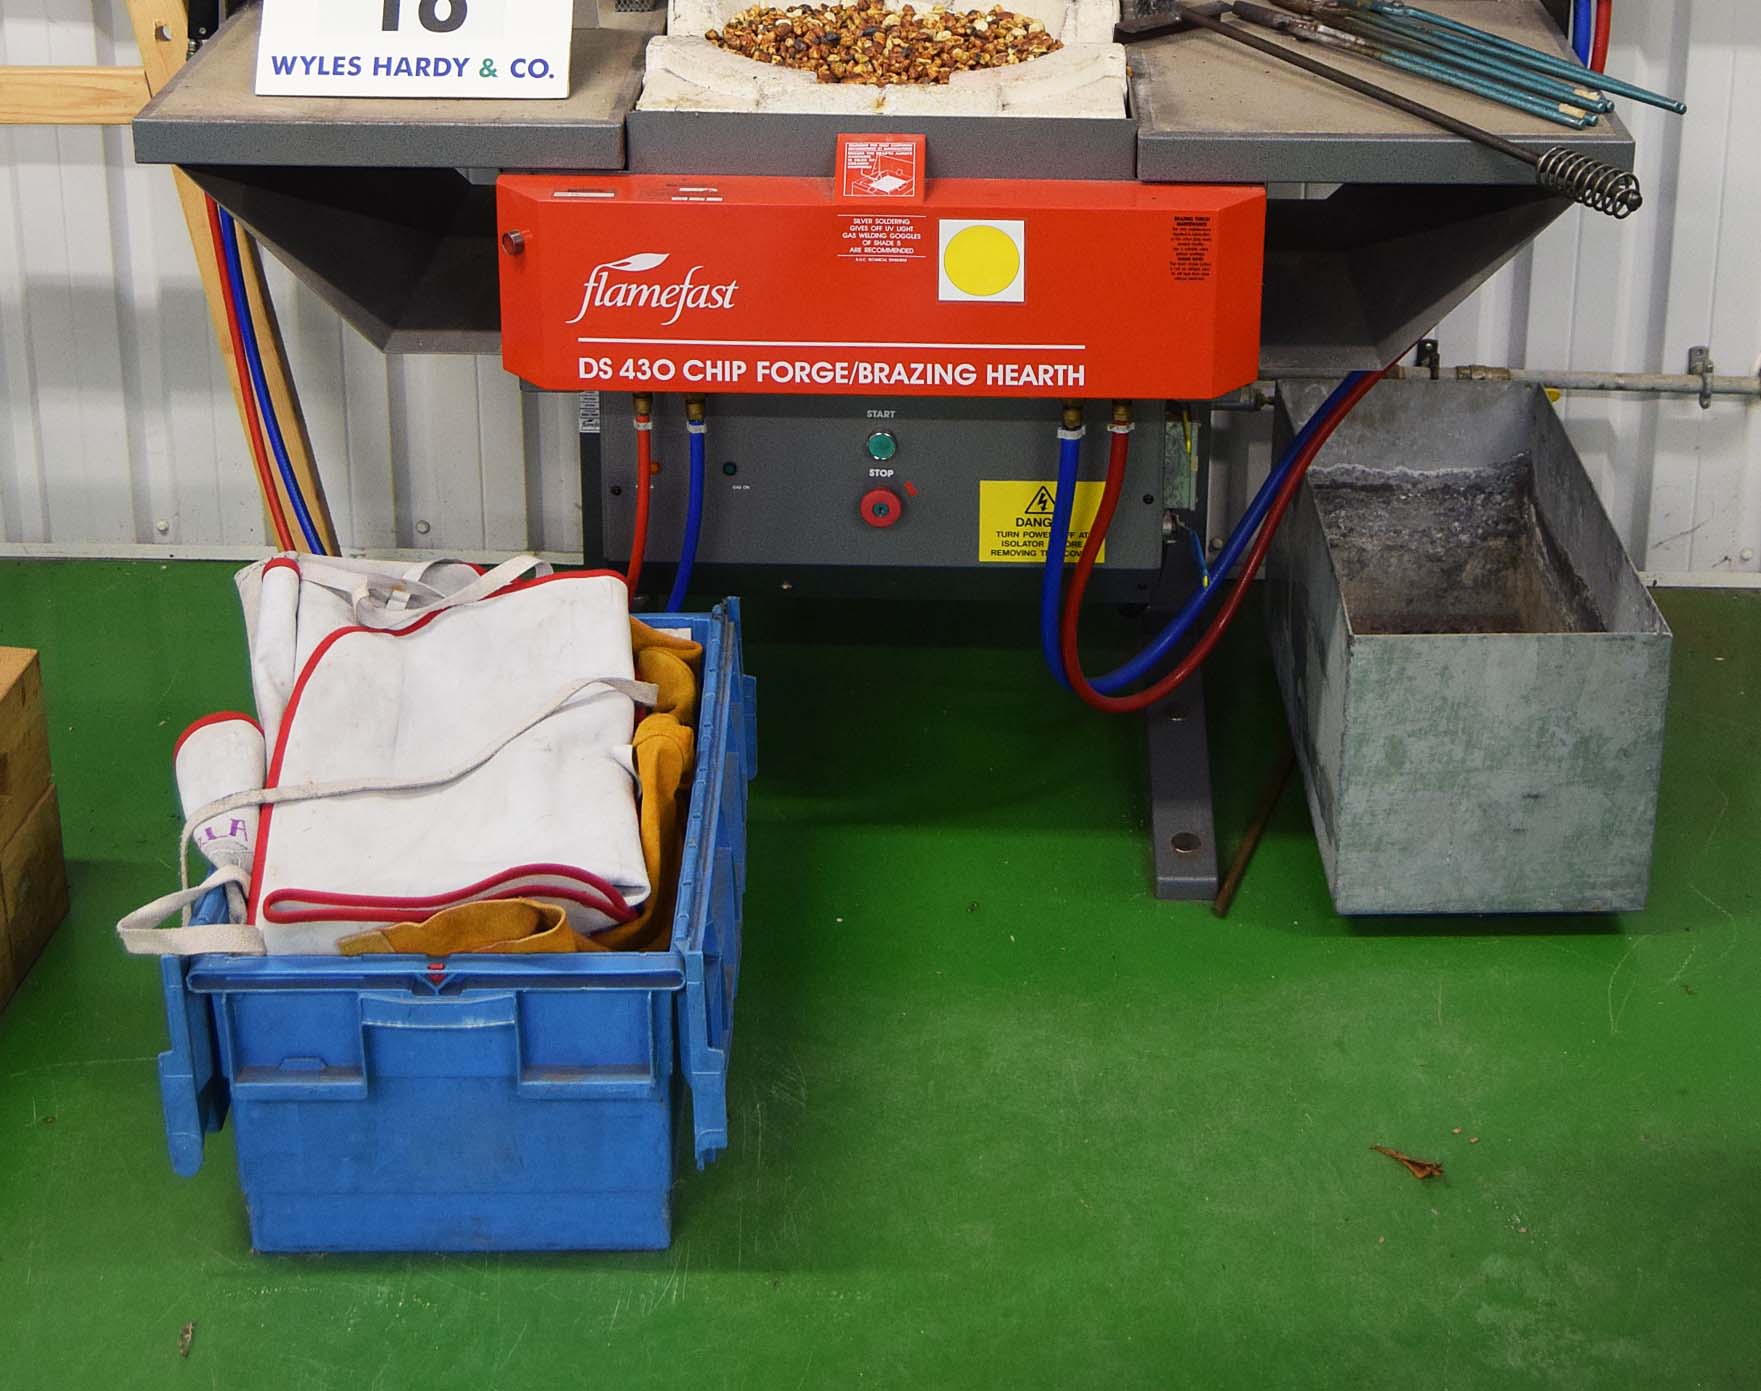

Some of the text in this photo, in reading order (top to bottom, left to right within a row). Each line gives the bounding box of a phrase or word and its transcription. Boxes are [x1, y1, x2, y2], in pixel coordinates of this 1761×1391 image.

[271, 55, 555, 79] WYLES HARDY & CO.
[565, 263, 739, 326] flamefast
[578, 357, 1085, 387] DS 430 CHIP FORGE/BRAZING HEARTH
[867, 410, 896, 418] START
[869, 469, 894, 478] STOP
[1016, 517, 1053, 528] DANG
[1023, 531, 1050, 539] POWE
[1001, 540, 1044, 548] ISOLATOR
[990, 549, 1037, 557] REMOVING
